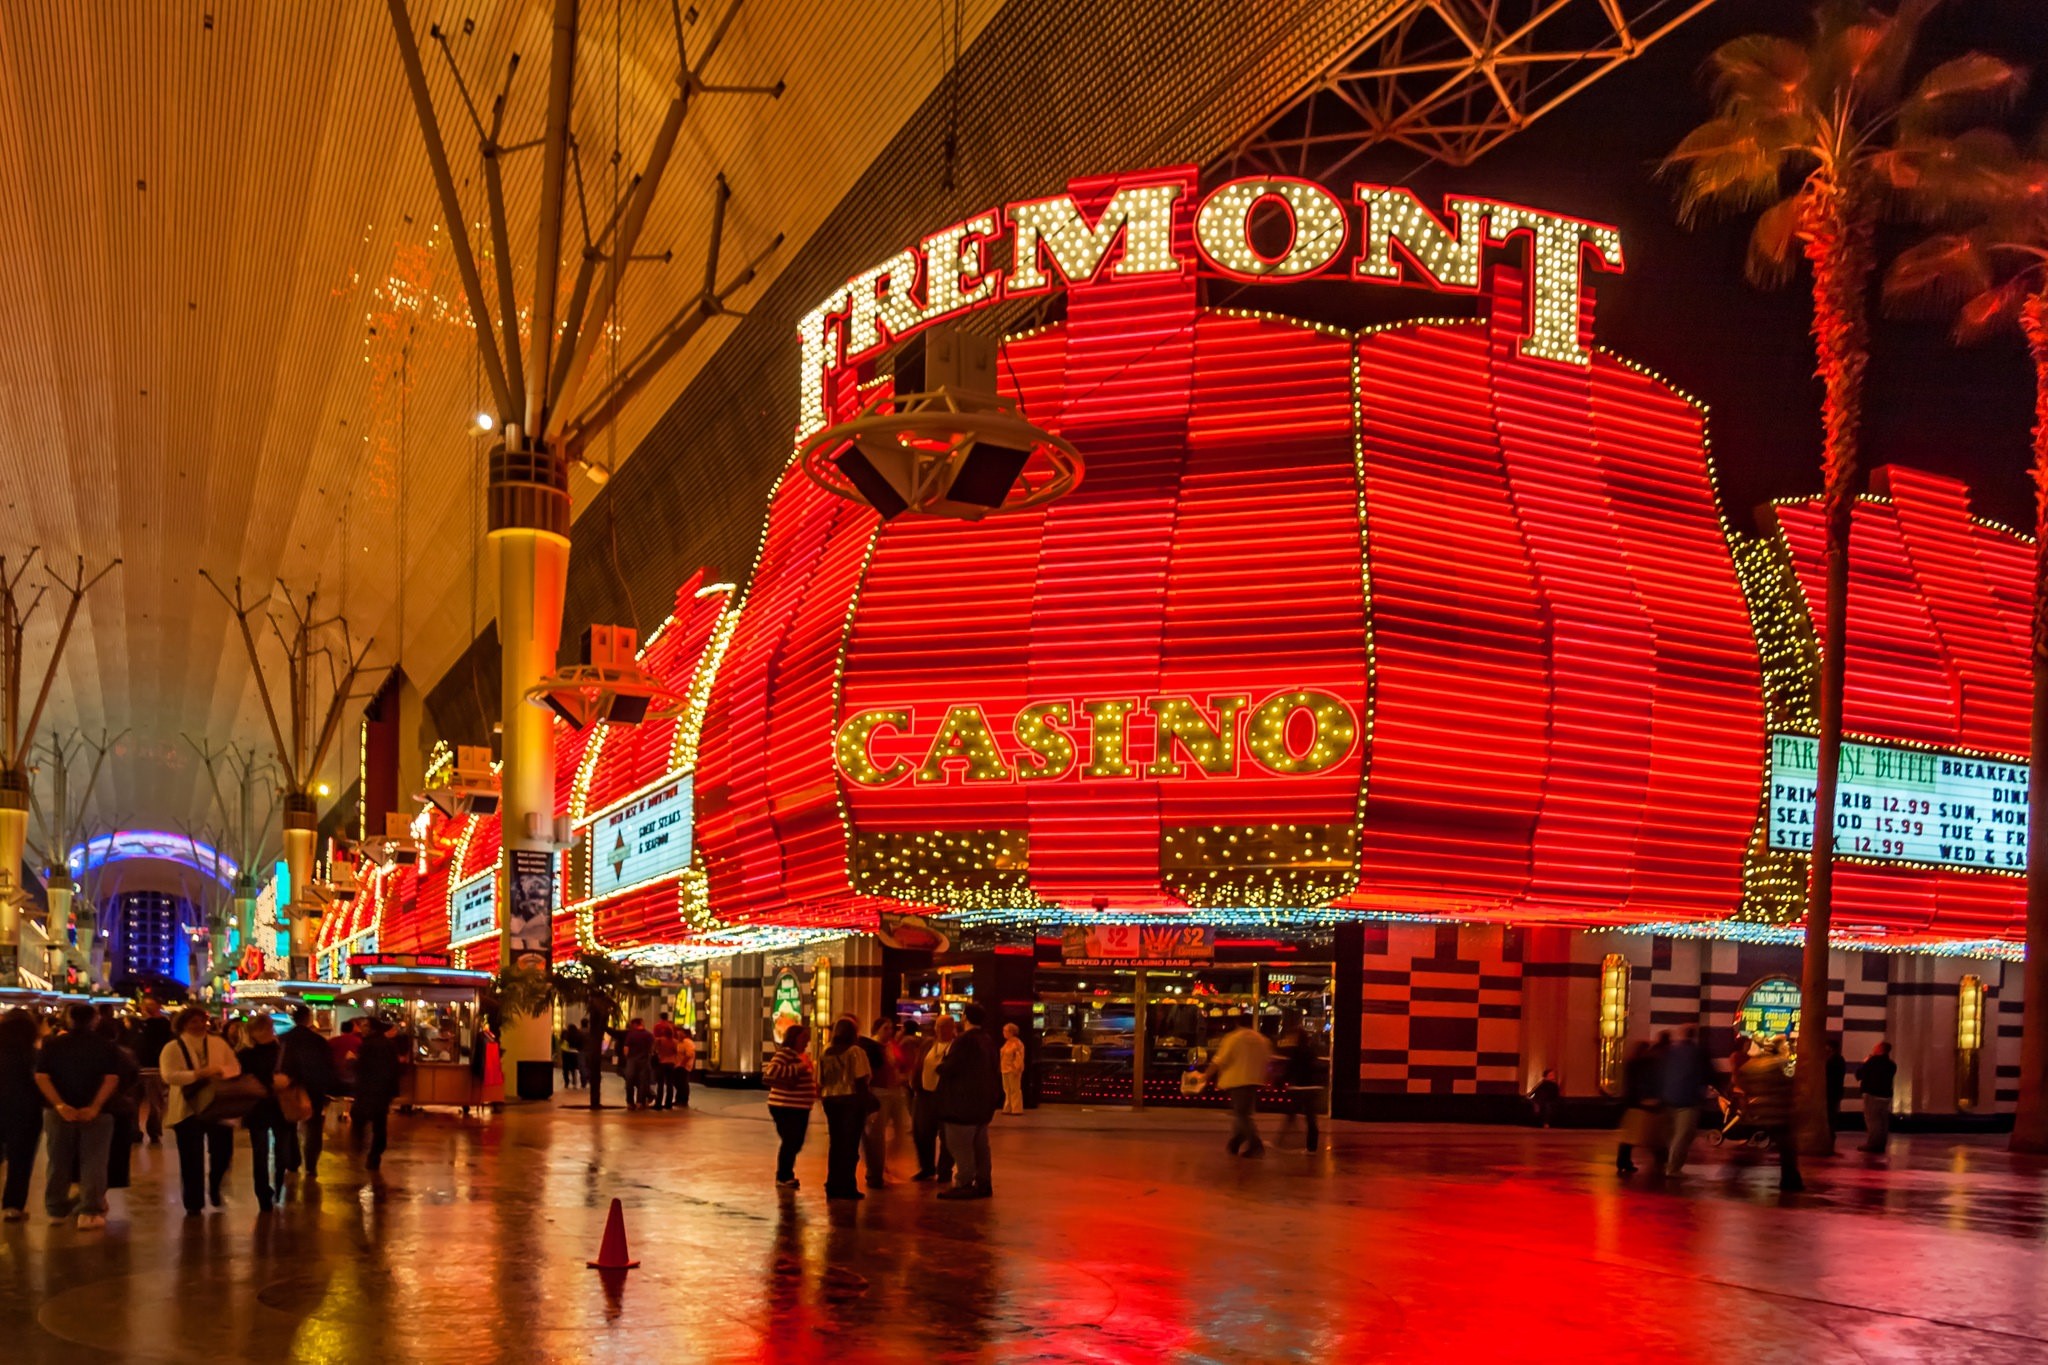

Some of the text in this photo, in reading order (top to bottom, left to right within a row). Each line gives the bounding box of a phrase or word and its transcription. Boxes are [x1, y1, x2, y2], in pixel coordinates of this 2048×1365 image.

[795, 174, 1624, 445] FREMONT
[836, 687, 1360, 790] CASINO
[1775, 737, 1938, 784] PARISE BUFFET
[1942, 760, 2027, 784] BREAKFAS
[658, 809, 681, 830] STEAKS
[1775, 784, 1817, 803] PRIM
[1842, 792, 1872, 810] RIB
[1883, 796, 1930, 815] 12.99
[1939, 803, 1981, 824] SUN,
[1777, 806, 2026, 847] SEAOD 15.99 TUE & FR
[1776, 829, 2025, 866] STEK 12.99 WED & SA
[1107, 927, 1128, 948] $2
[1183, 926, 1204, 947] $2
[1066, 958, 1100, 966] SERVED
[1101, 959, 1113, 967] AT
[1130, 959, 1164, 967] CASINO
[1165, 959, 1190, 967] BARS
